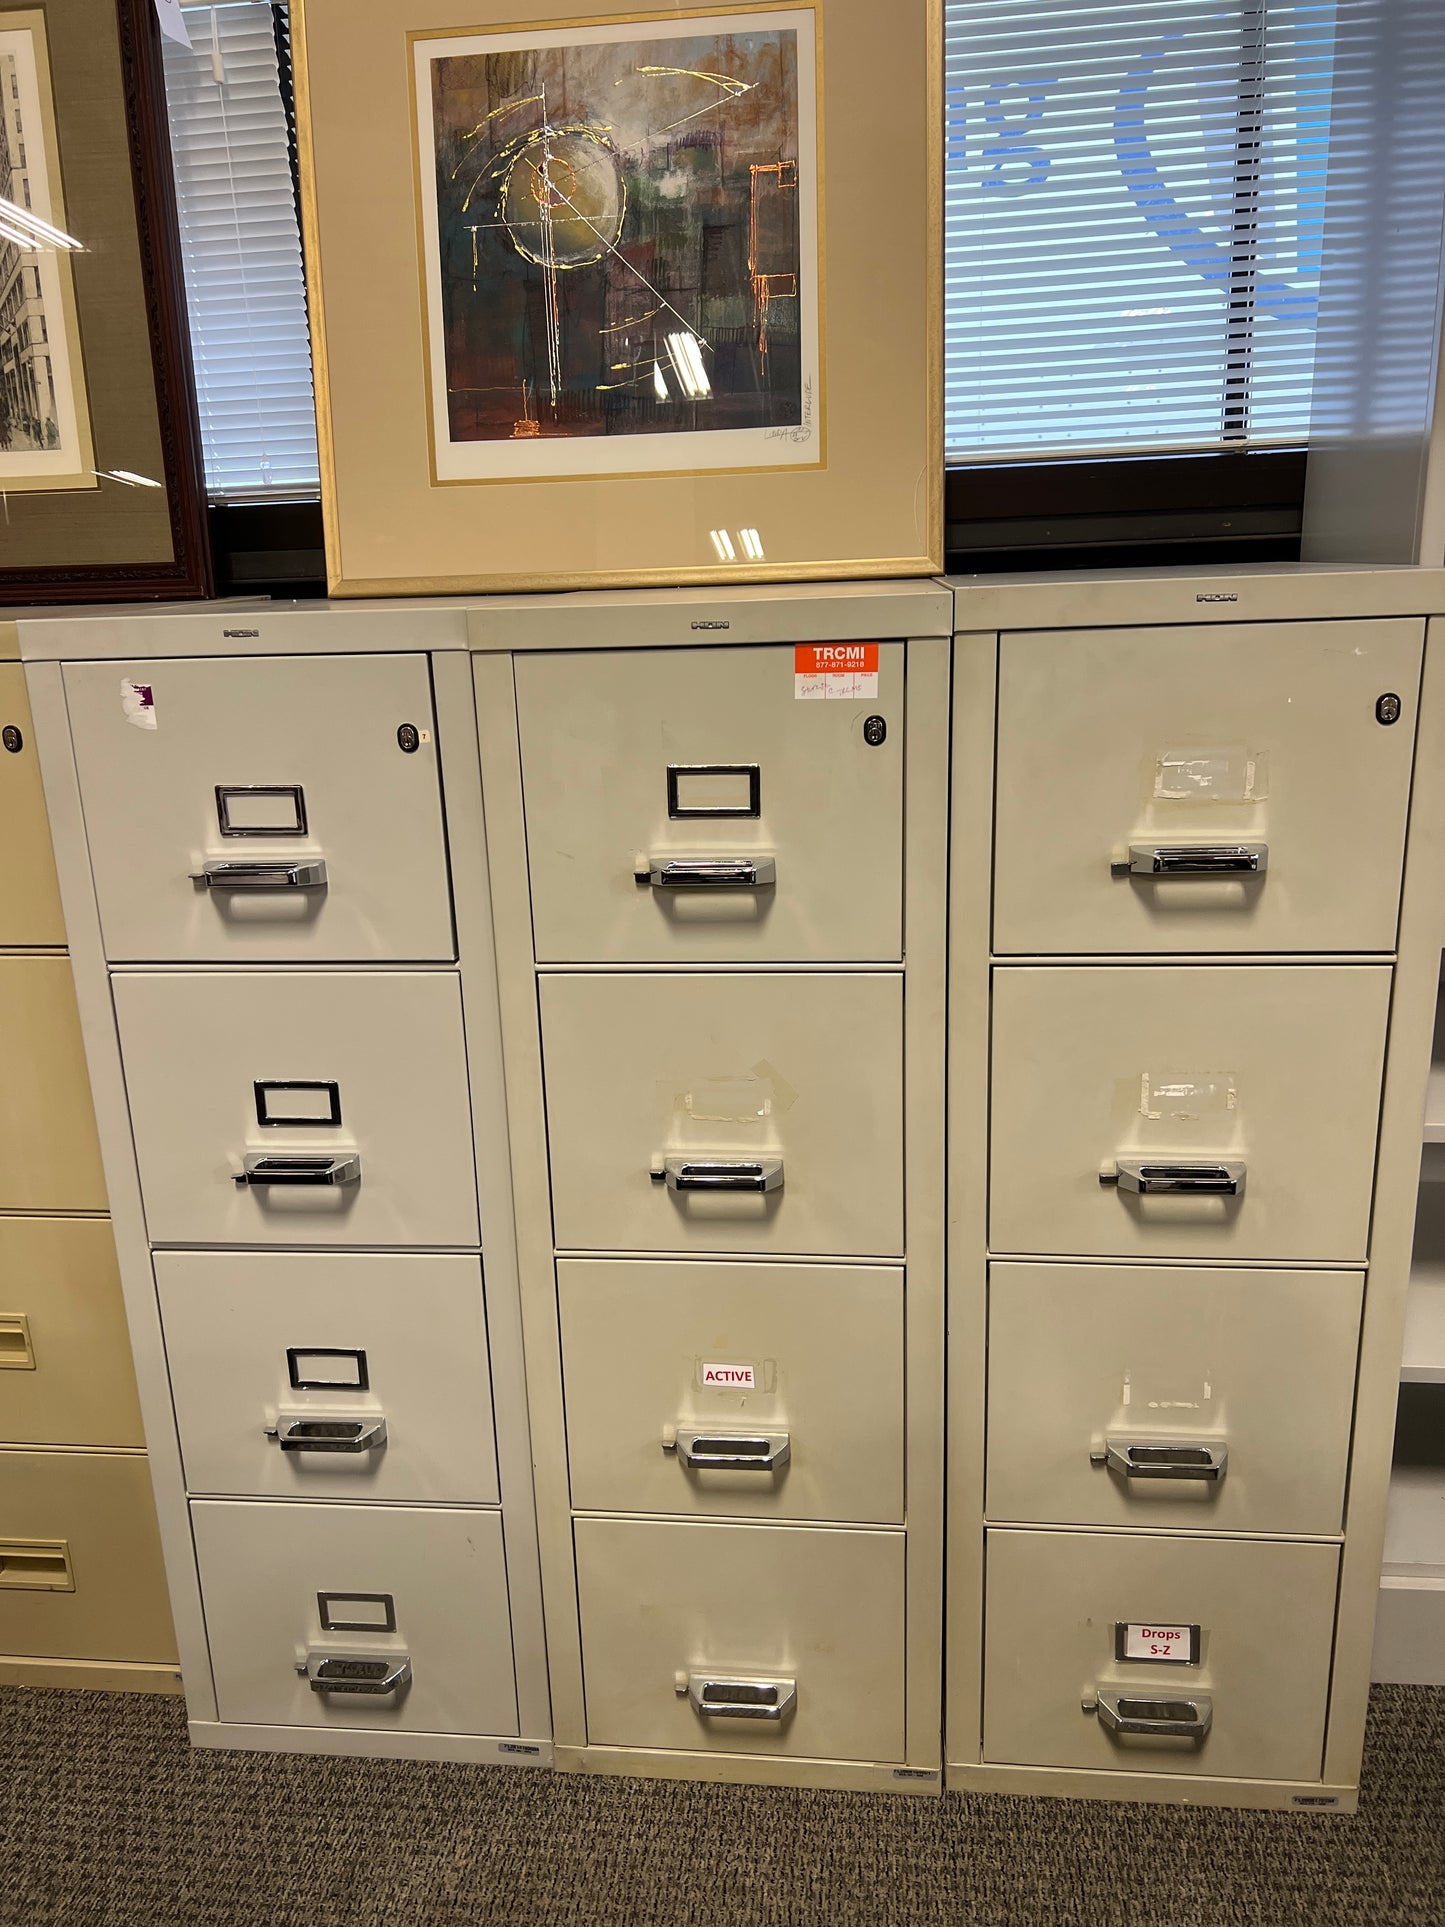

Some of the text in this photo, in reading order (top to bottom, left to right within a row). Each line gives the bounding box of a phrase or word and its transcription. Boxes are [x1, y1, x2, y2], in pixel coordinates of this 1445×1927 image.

[1196, 593, 1238, 602] HON
[690, 621, 730, 630] HON
[223, 629, 260, 637] HON
[813, 646, 865, 660] TRCMI
[705, 1370, 752, 1382] ACTIVE
[1141, 1628, 1181, 1641] Drops
[1150, 1644, 1171, 1655] S-Z
